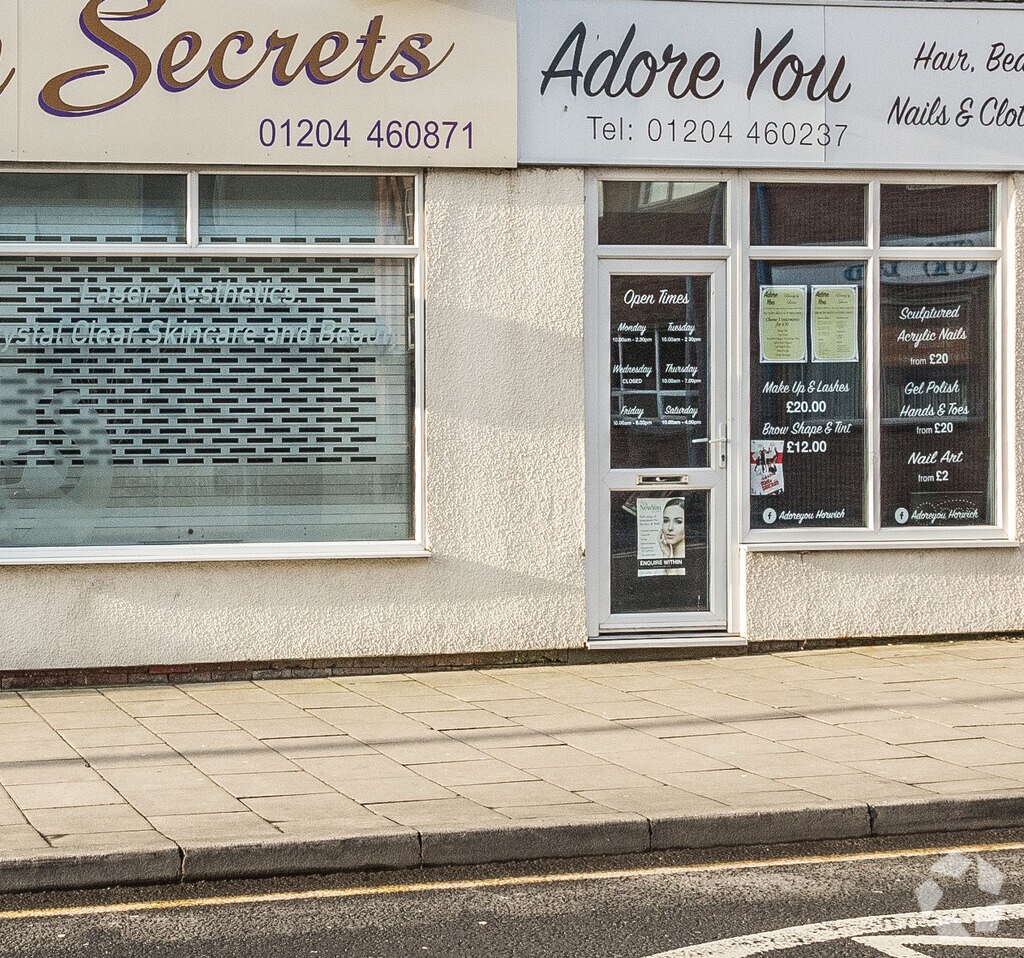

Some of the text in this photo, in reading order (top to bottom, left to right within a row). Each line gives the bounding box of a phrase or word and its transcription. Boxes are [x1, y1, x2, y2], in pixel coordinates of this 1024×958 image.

[540, 21, 852, 103] Adore You
[913, 41, 975, 73] Hair,
[887, 95, 951, 126] Nails
[955, 96, 974, 128] &
[258, 118, 474, 149] 01204 460871
[586, 117, 849, 147] Tel: 01204 460237
[624, 289, 690, 308] Open Times
[899, 304, 961, 322] Sculptured
[72, 319, 140, 345] Clear
[145, 318, 256, 345] Skincare
[265, 319, 318, 345] and
[617, 323, 646, 336] Monday
[667, 322, 695, 335] Tuesday
[897, 327, 967, 348] Acrylic Nails
[910, 353, 948, 365] from £20
[613, 364, 652, 377] Wednesday
[665, 364, 698, 377] Thursday
[762, 379, 850, 396] Make Up & Lashes
[904, 380, 960, 395] Gel Polish
[620, 405, 644, 419] Friday
[665, 405, 698, 418] Saturday
[786, 401, 826, 413] £20.00
[900, 402, 969, 417] Hands & Toes
[762, 420, 852, 437] Brow Shape & Tint
[916, 422, 953, 434] from £20
[786, 440, 827, 453] £12.00
[907, 450, 964, 464] Nail Art
[918, 470, 949, 482] from £2
[779, 509, 845, 524] Adoreyou Horwich
[911, 509, 979, 523] Adoreyou Horwich
